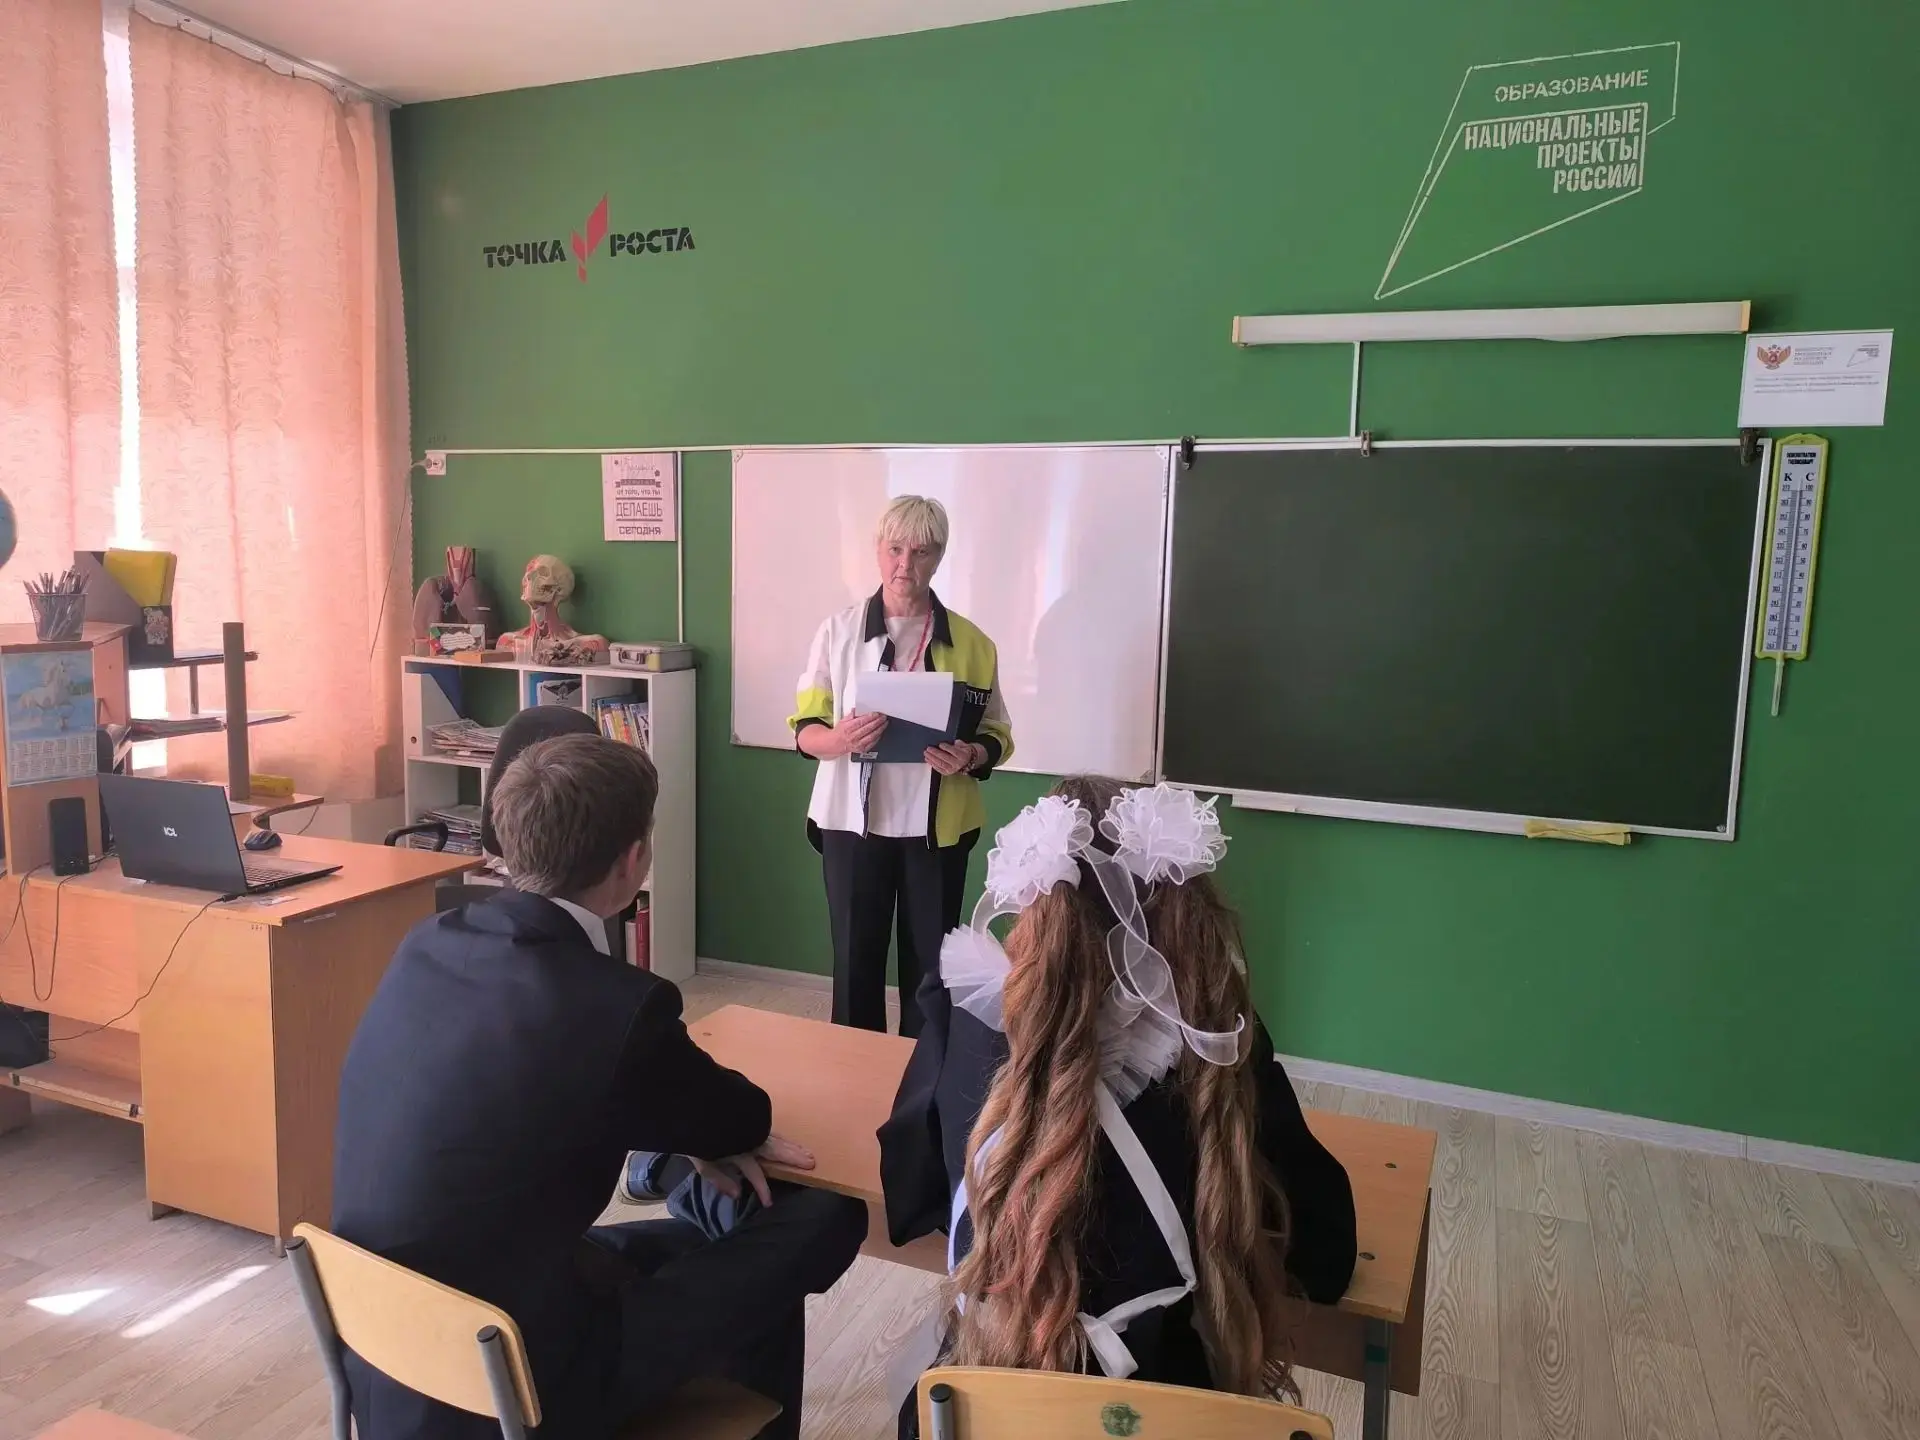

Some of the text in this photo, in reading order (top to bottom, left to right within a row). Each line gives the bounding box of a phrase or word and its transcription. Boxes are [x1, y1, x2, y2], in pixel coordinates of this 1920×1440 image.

[1494, 69, 1649, 102] ОБРАЗОВАНИЕ
[1464, 107, 1641, 150] НАЦИОНАЛЬНЫЕ
[1537, 135, 1639, 169] ПРОЕКТЫ
[1553, 163, 1637, 194] РОССИИ
[483, 226, 696, 268] ТОЧКА РОСТА
[1784, 472, 1792, 481] K
[616, 502, 663, 518] ДЕЛАЕШЬ
